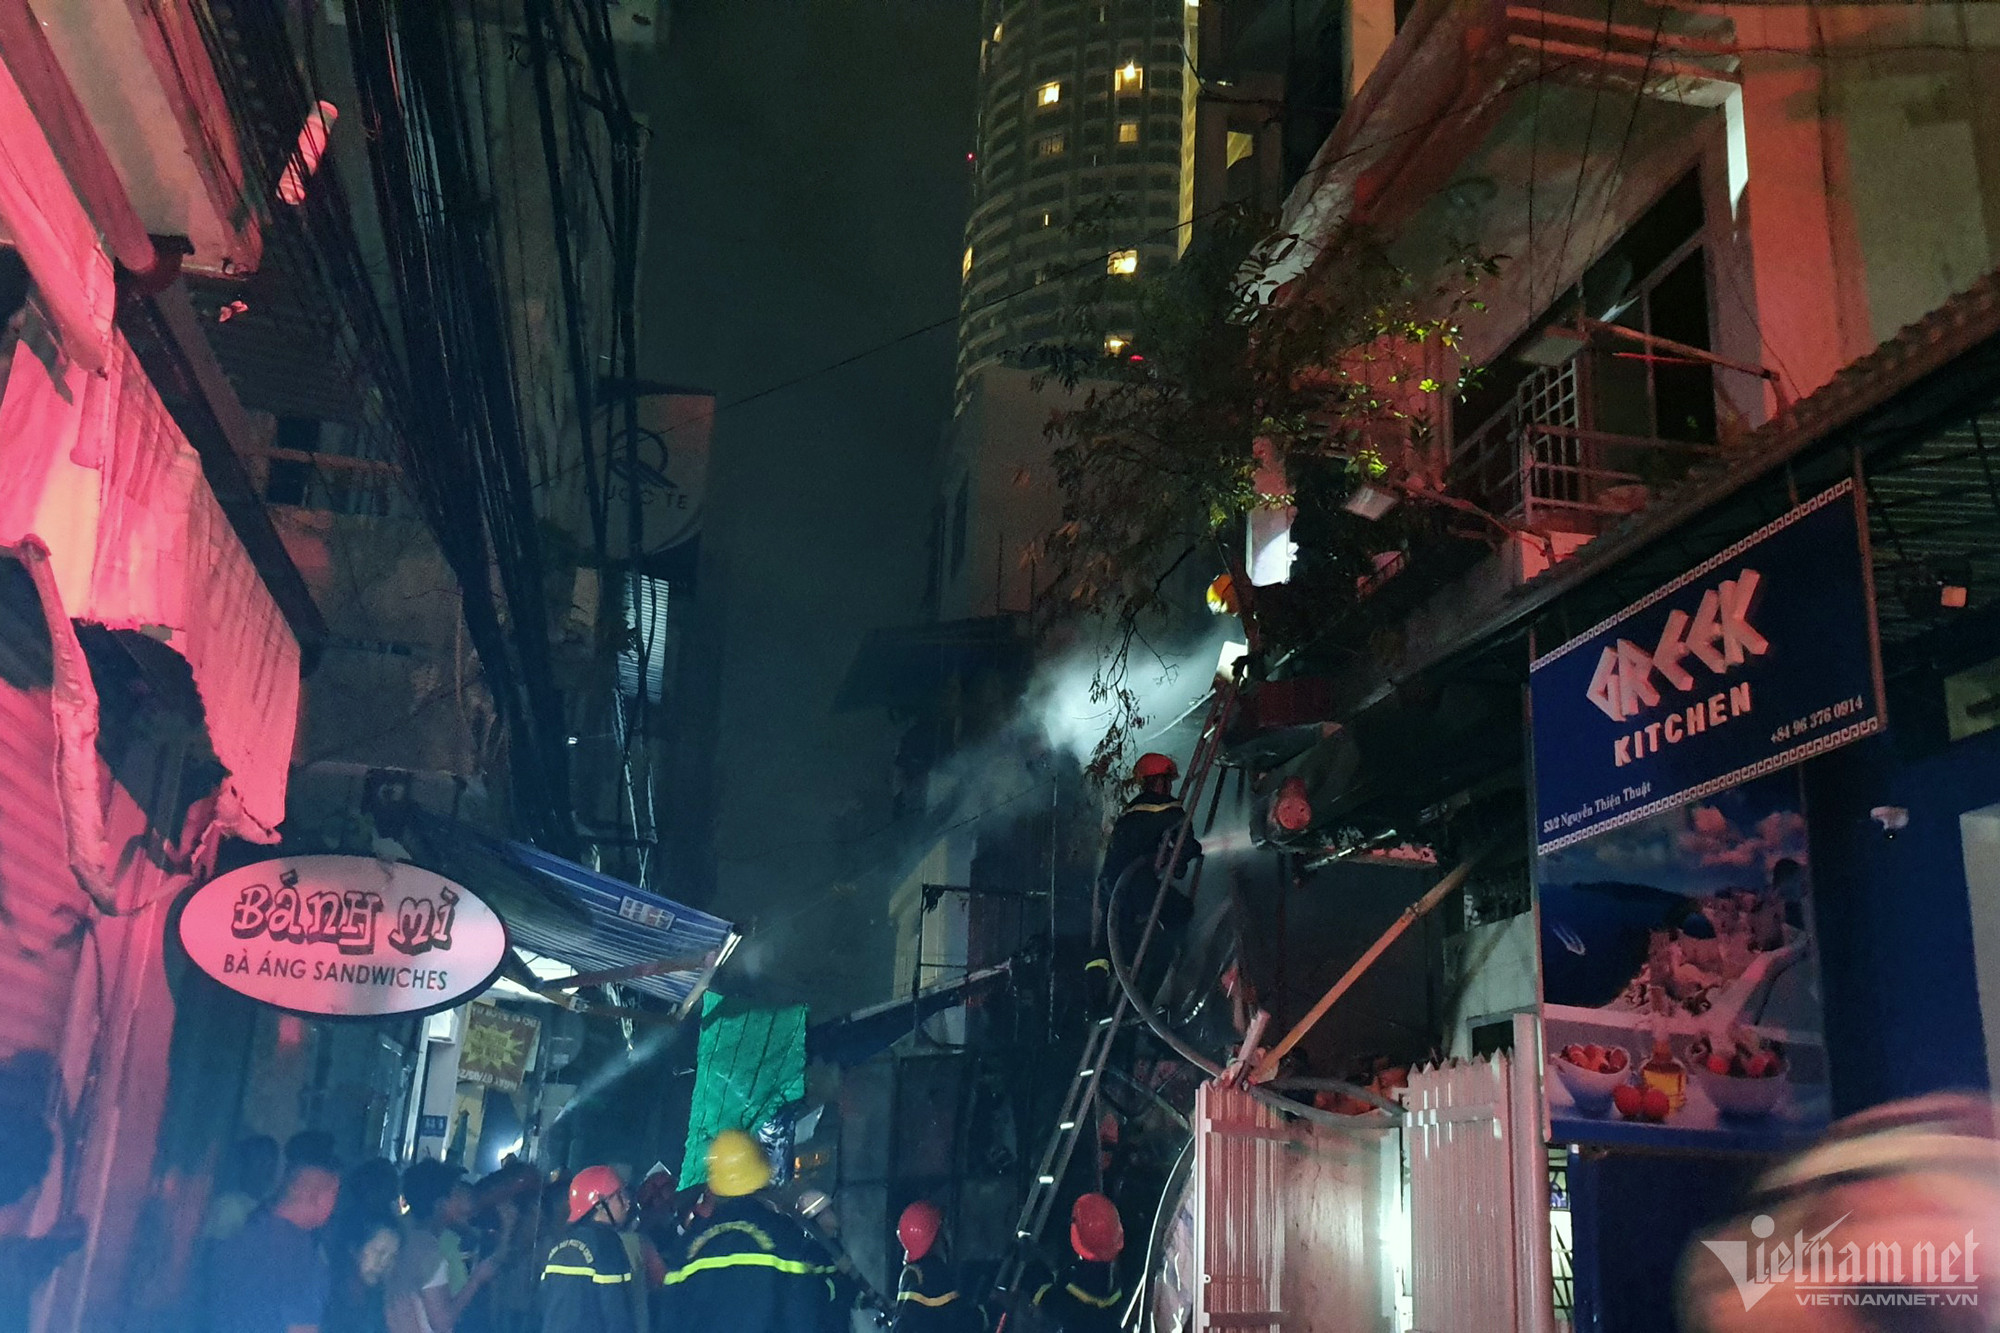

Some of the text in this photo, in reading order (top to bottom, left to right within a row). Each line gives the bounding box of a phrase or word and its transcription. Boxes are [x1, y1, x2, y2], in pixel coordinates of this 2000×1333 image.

[1613, 681, 1753, 768] KITCHEN
[223, 949, 449, 991] BÀ ÁNG SANDWICHES
